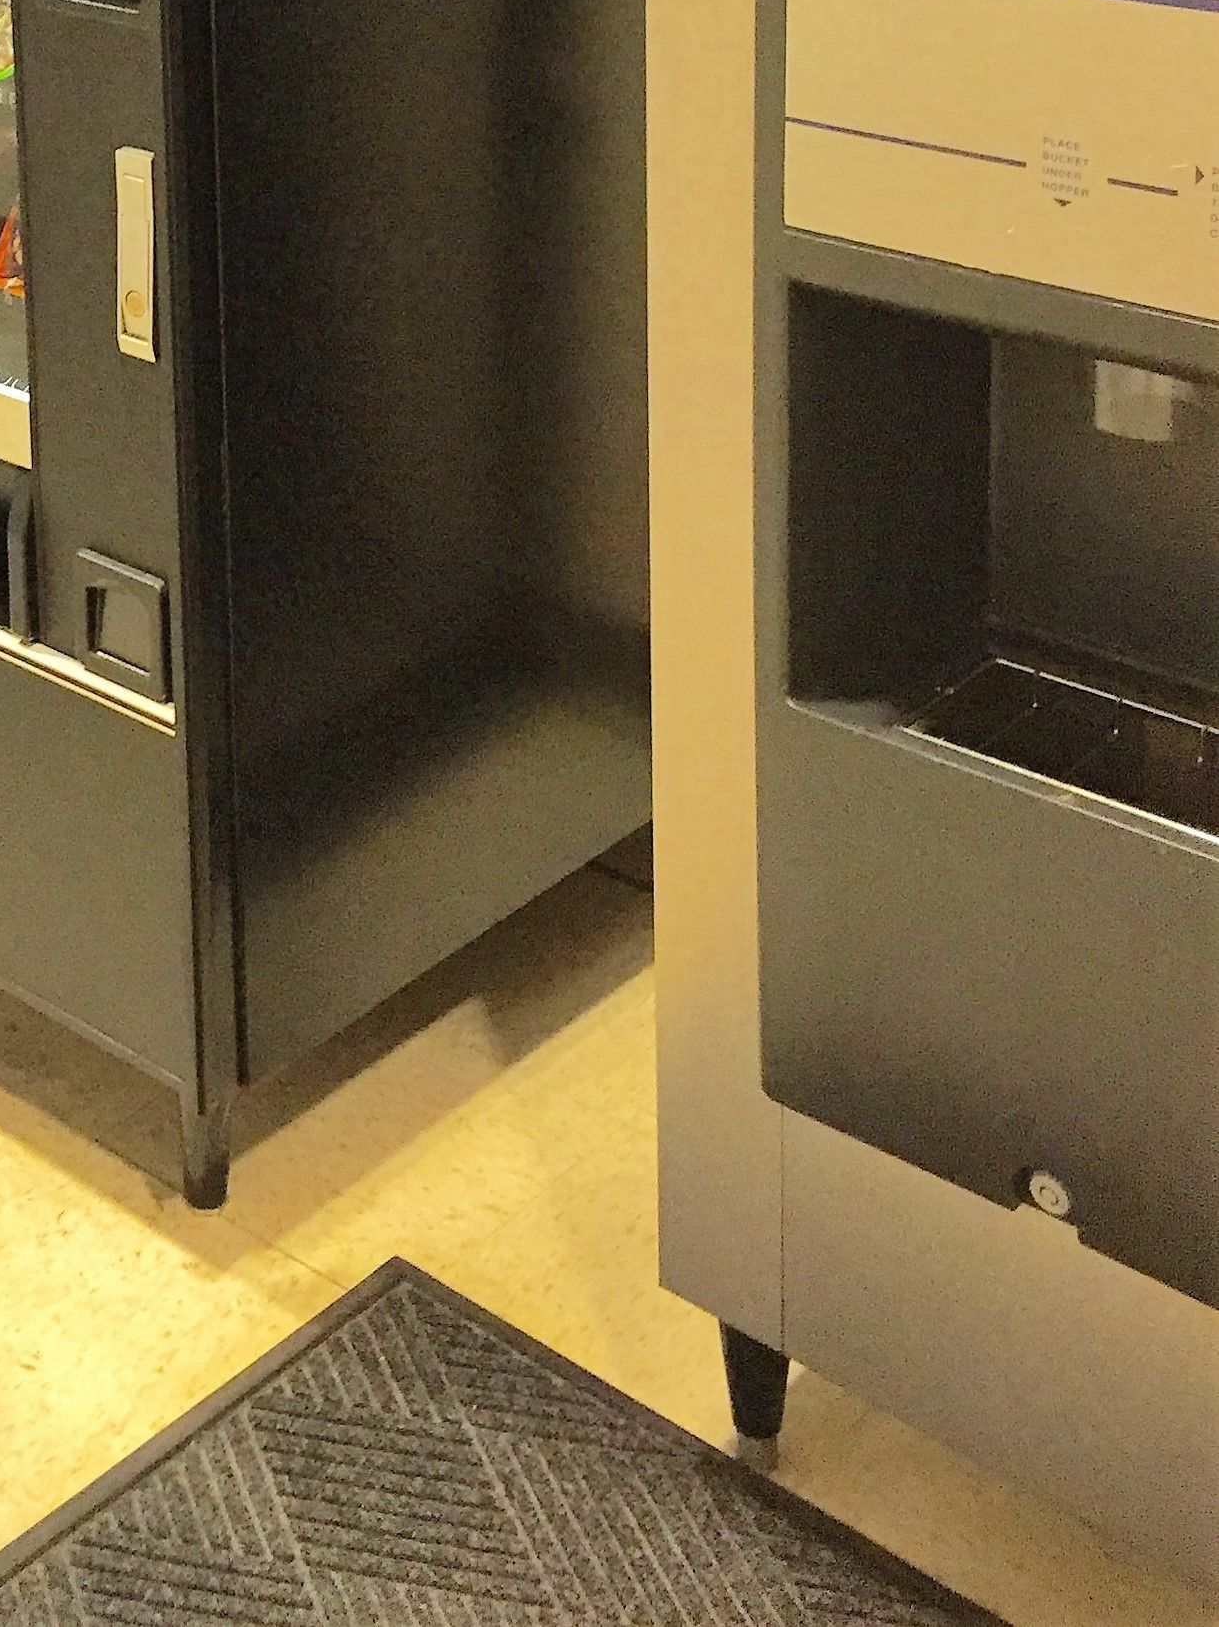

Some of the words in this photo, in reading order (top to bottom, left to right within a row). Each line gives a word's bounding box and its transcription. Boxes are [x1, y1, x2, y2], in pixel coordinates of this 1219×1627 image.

[1042, 136, 1081, 151] PLACE
[1042, 151, 1090, 167] BUCKET
[1041, 166, 1082, 181] UNDER
[1041, 181, 1090, 198] HOPPER
